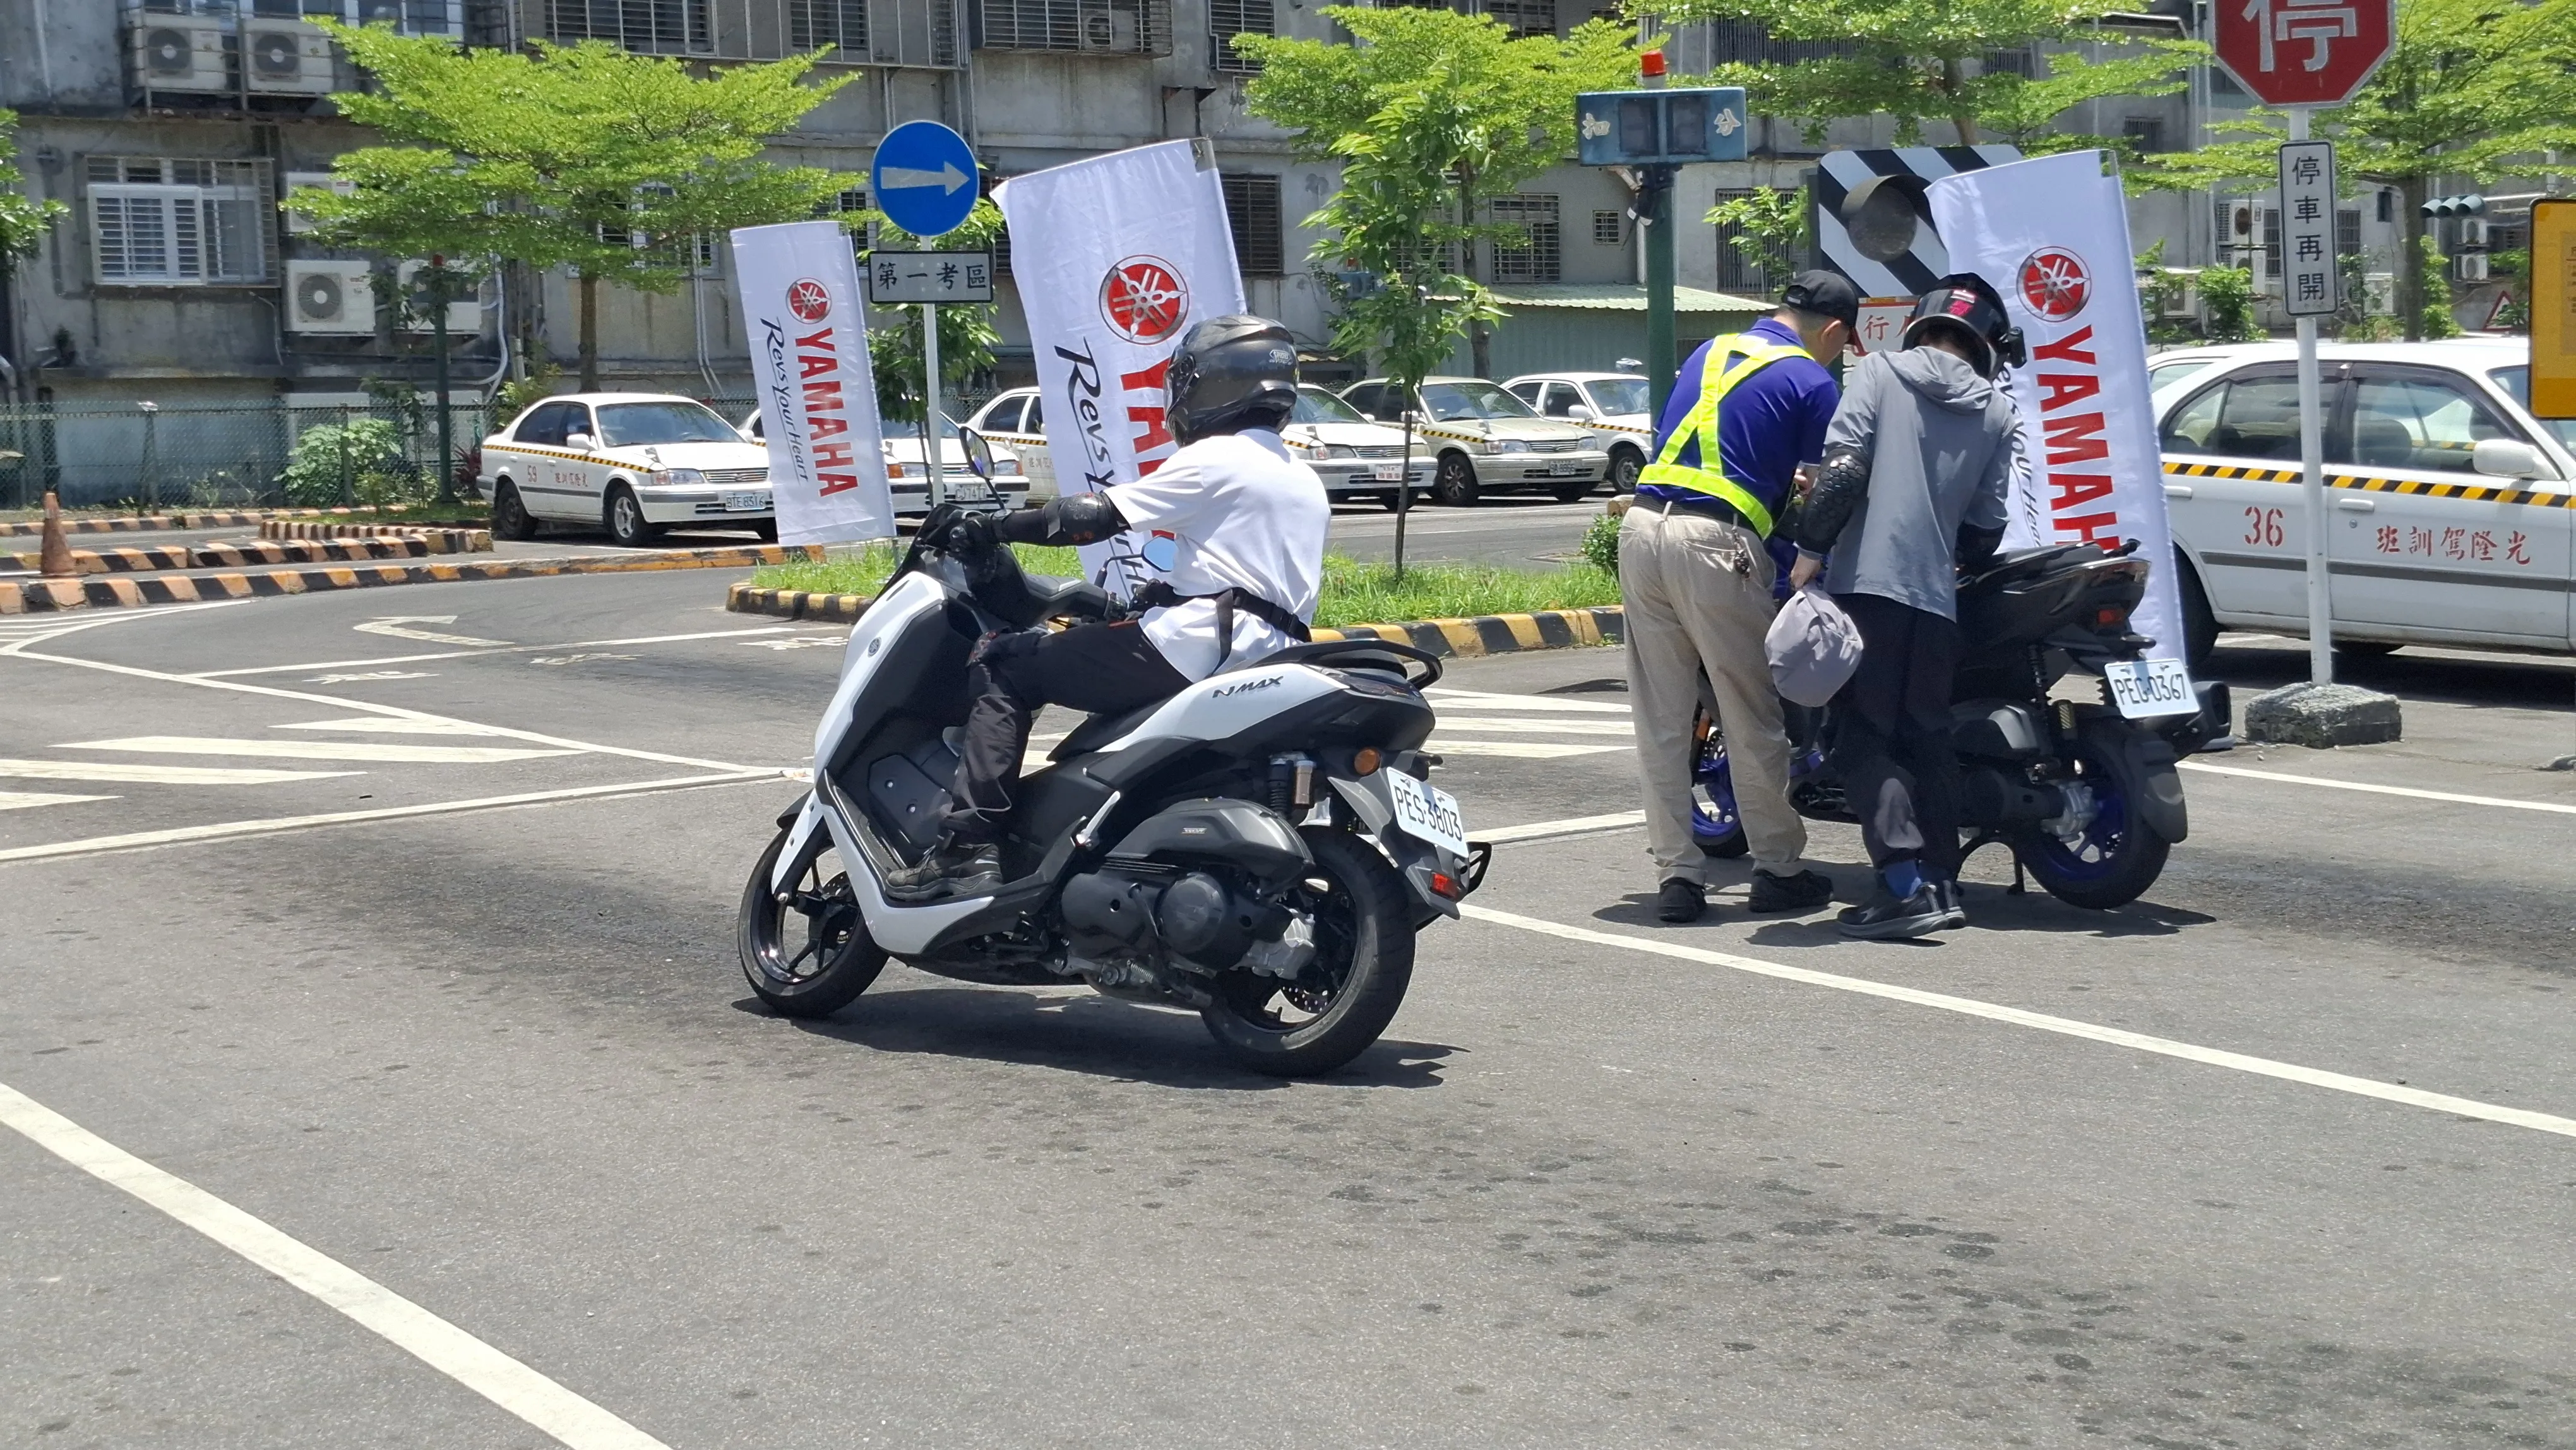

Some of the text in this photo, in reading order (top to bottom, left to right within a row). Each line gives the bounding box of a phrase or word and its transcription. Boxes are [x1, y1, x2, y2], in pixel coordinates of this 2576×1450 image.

[877, 261, 987, 291] 第一考區
[2292, 155, 2325, 303] 停車再開
[760, 316, 809, 482] Revs Your Heart
[795, 327, 859, 498] YAMAHA
[1054, 336, 1112, 464] Revs
[2032, 323, 2124, 553] YAMAH
[2244, 506, 2284, 547] 36
[1212, 675, 1284, 698] NMAX
